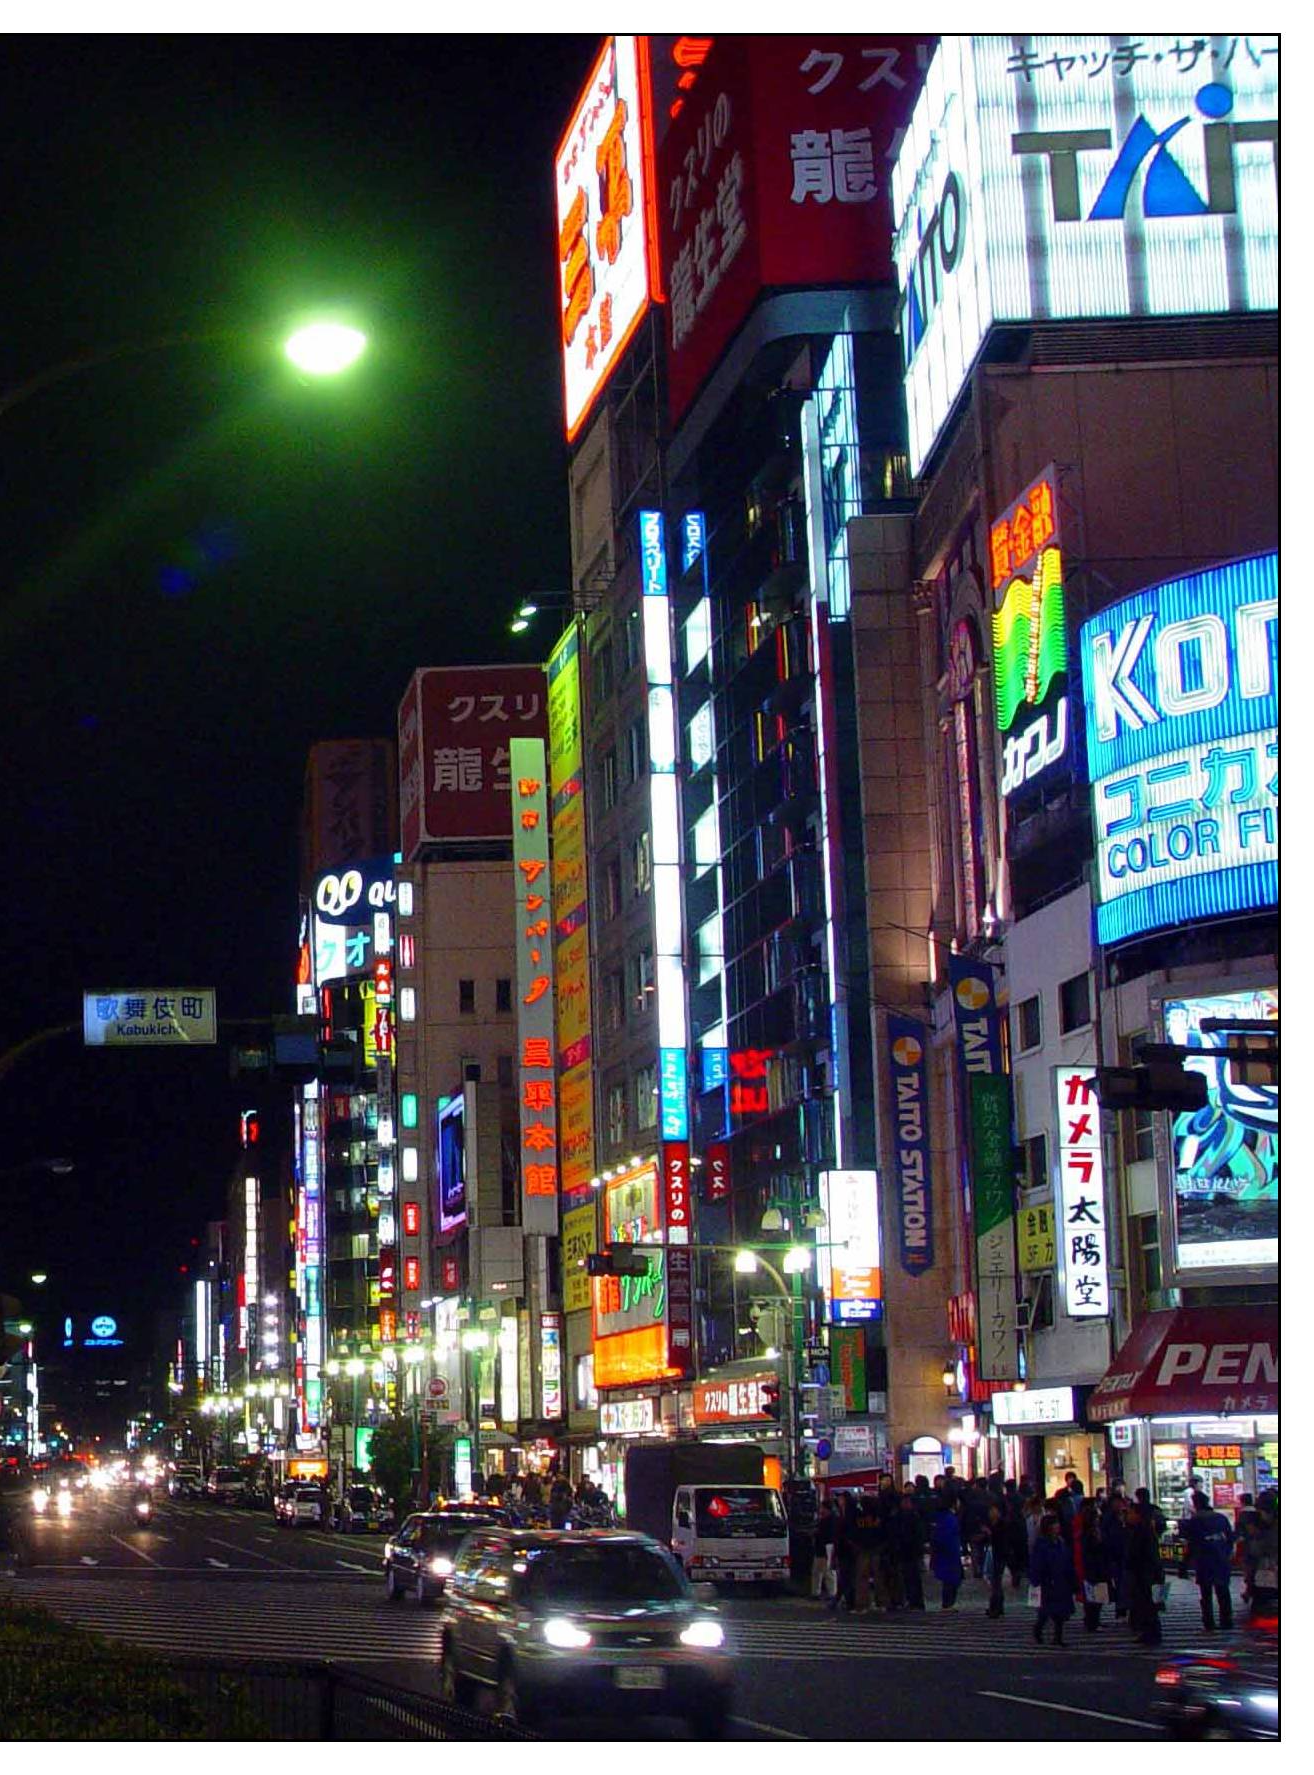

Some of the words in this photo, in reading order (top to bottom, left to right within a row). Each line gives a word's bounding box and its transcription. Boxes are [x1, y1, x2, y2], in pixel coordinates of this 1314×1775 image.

[447, 693, 540, 724] クスリ
[1103, 742, 1278, 838] コニカ
[1106, 816, 1221, 880] COLOR
[96, 996, 204, 1021] 歌舞伎町
[522, 1036, 558, 1197] 三平本館
[894, 1073, 923, 1143] TAITO
[669, 1159, 685, 1221] クスリの
[898, 1149, 929, 1248] STATION
[988, 1234, 1007, 1359] ジュエリーカワノ
